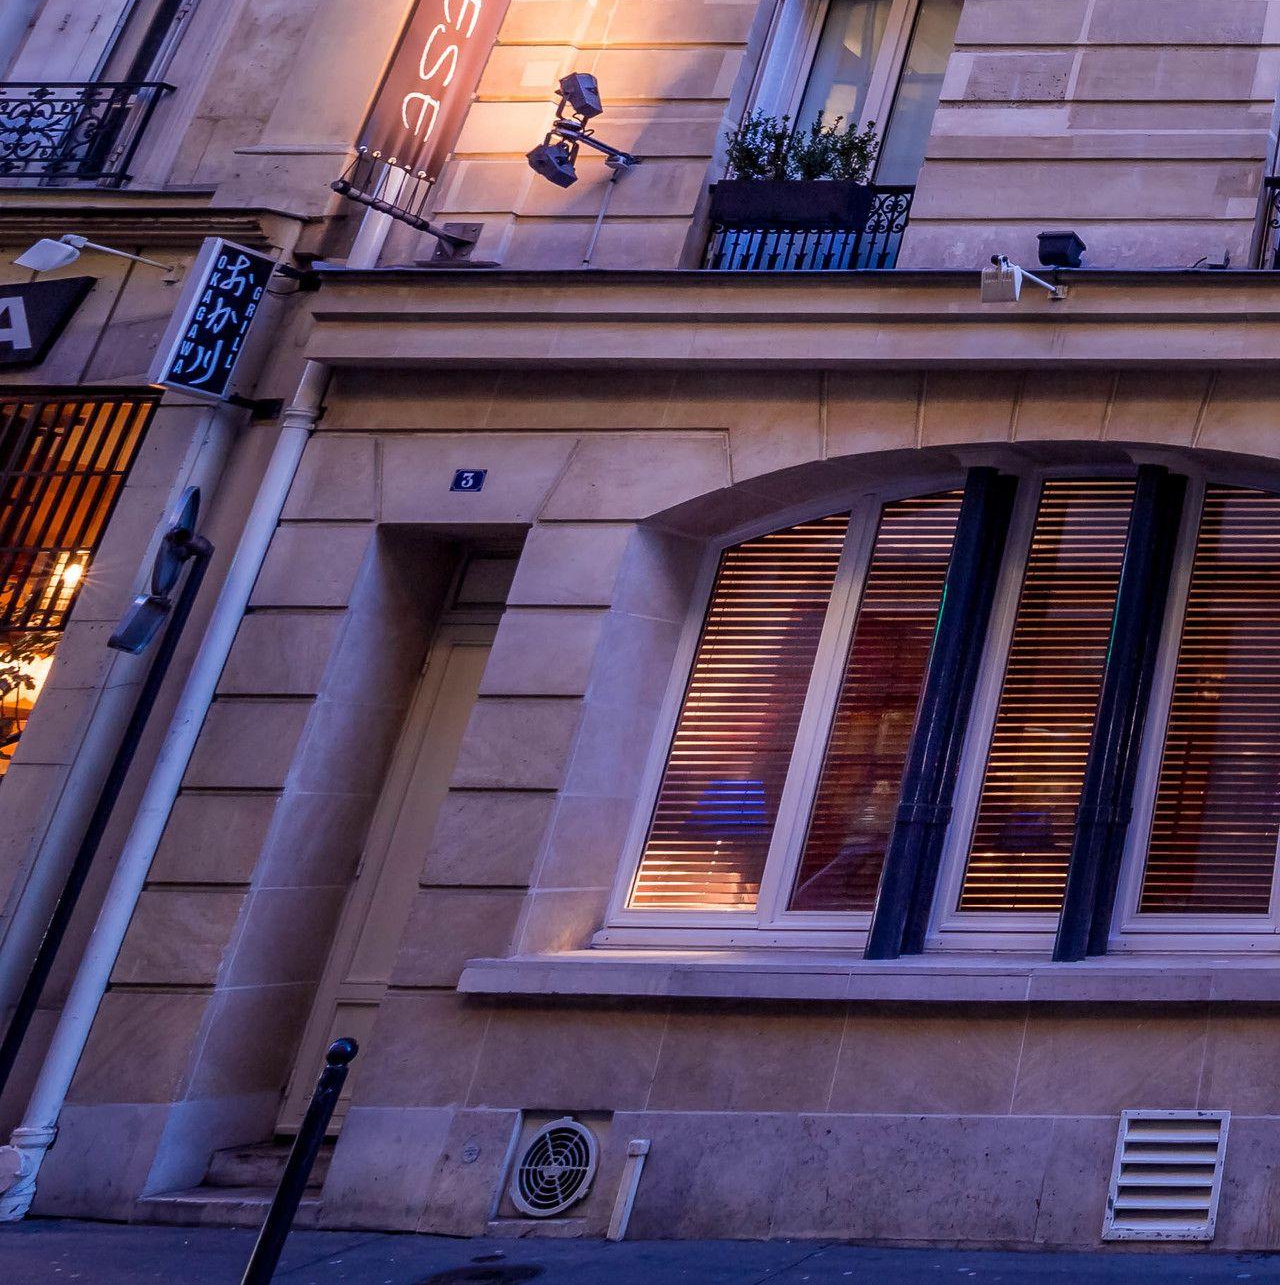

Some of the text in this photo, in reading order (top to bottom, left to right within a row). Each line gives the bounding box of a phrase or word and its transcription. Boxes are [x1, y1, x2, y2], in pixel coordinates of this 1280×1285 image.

[172, 255, 228, 374] OKAGAWA
[225, 286, 263, 369] GRILL
[461, 472, 475, 488] 3
